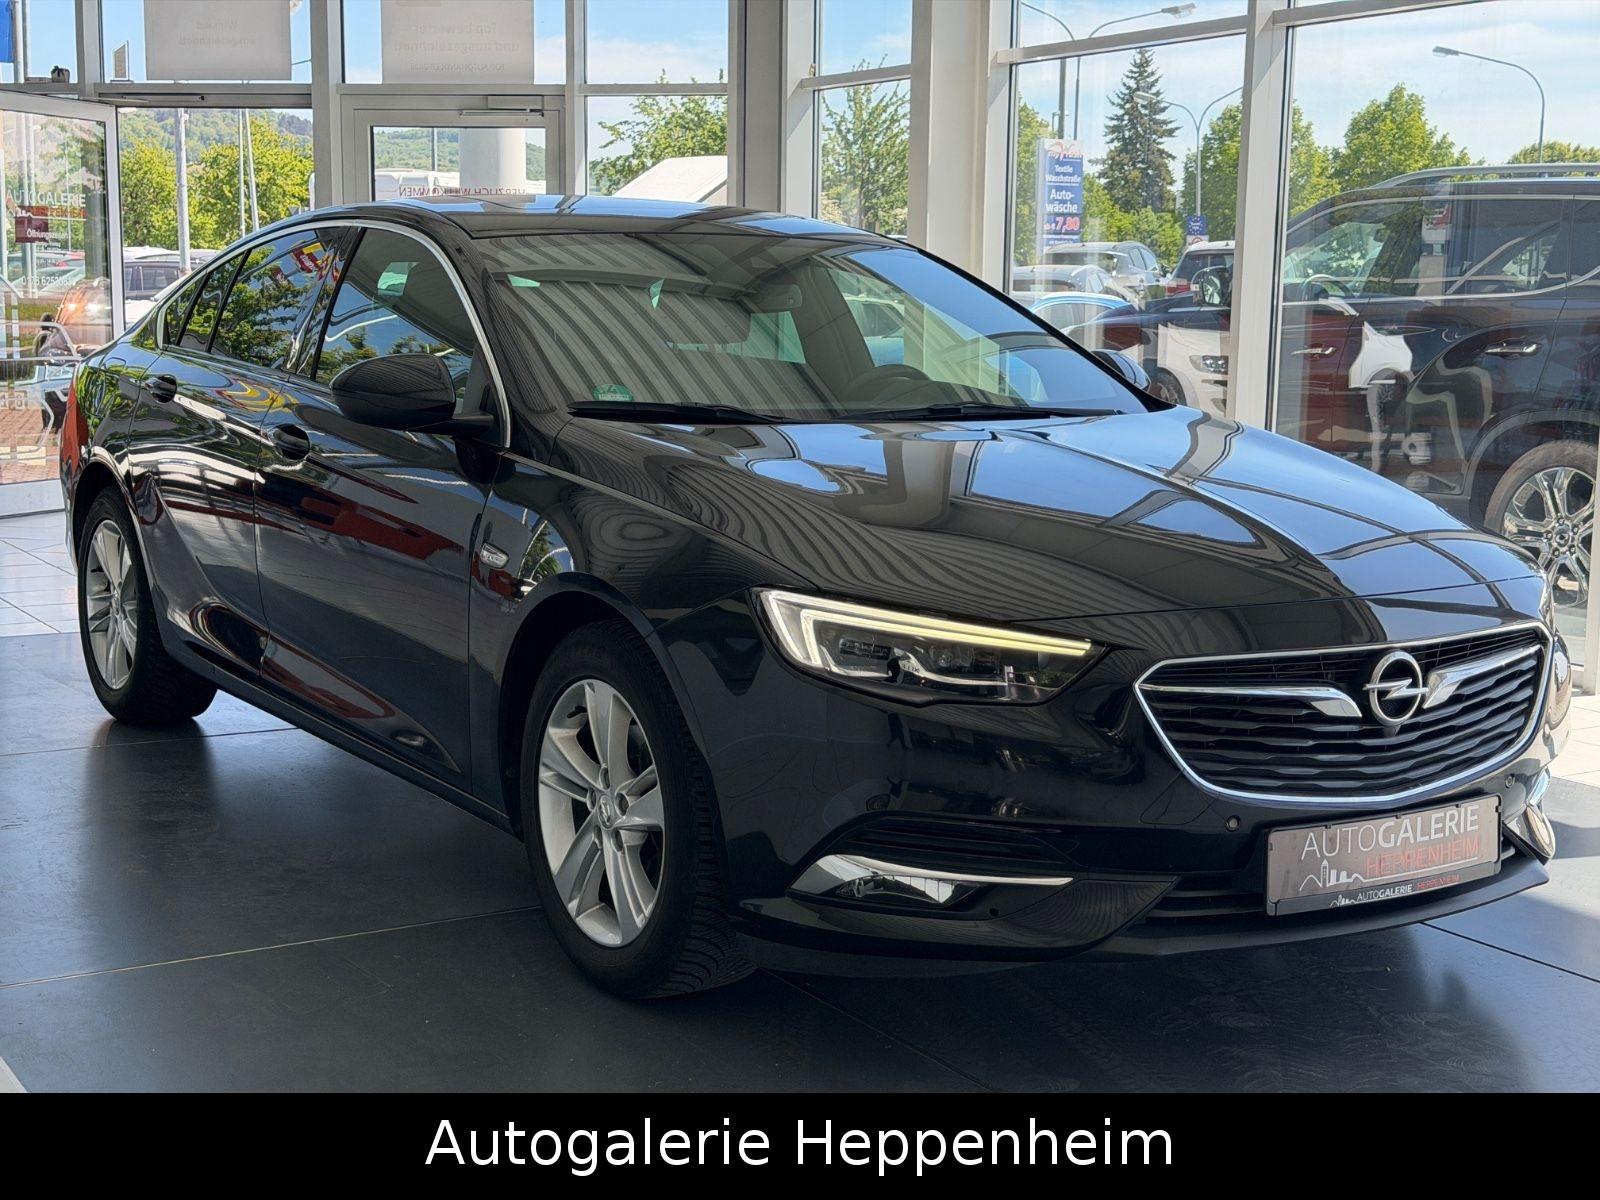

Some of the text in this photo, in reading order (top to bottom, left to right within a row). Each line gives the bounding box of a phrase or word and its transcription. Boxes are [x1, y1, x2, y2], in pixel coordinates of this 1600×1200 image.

[1055, 164, 1073, 173] Textile
[1045, 174, 1081, 183] Waschstraße
[6, 189, 86, 207] AUTOGALERIE
[1050, 189, 1075, 200] Auto-
[1045, 202, 1078, 213] wäsche
[1301, 804, 1479, 860] AUTOGALERIE
[1366, 835, 1479, 877] HEPPENHEIM
[1357, 884, 1413, 902] AUTOGALERIE
